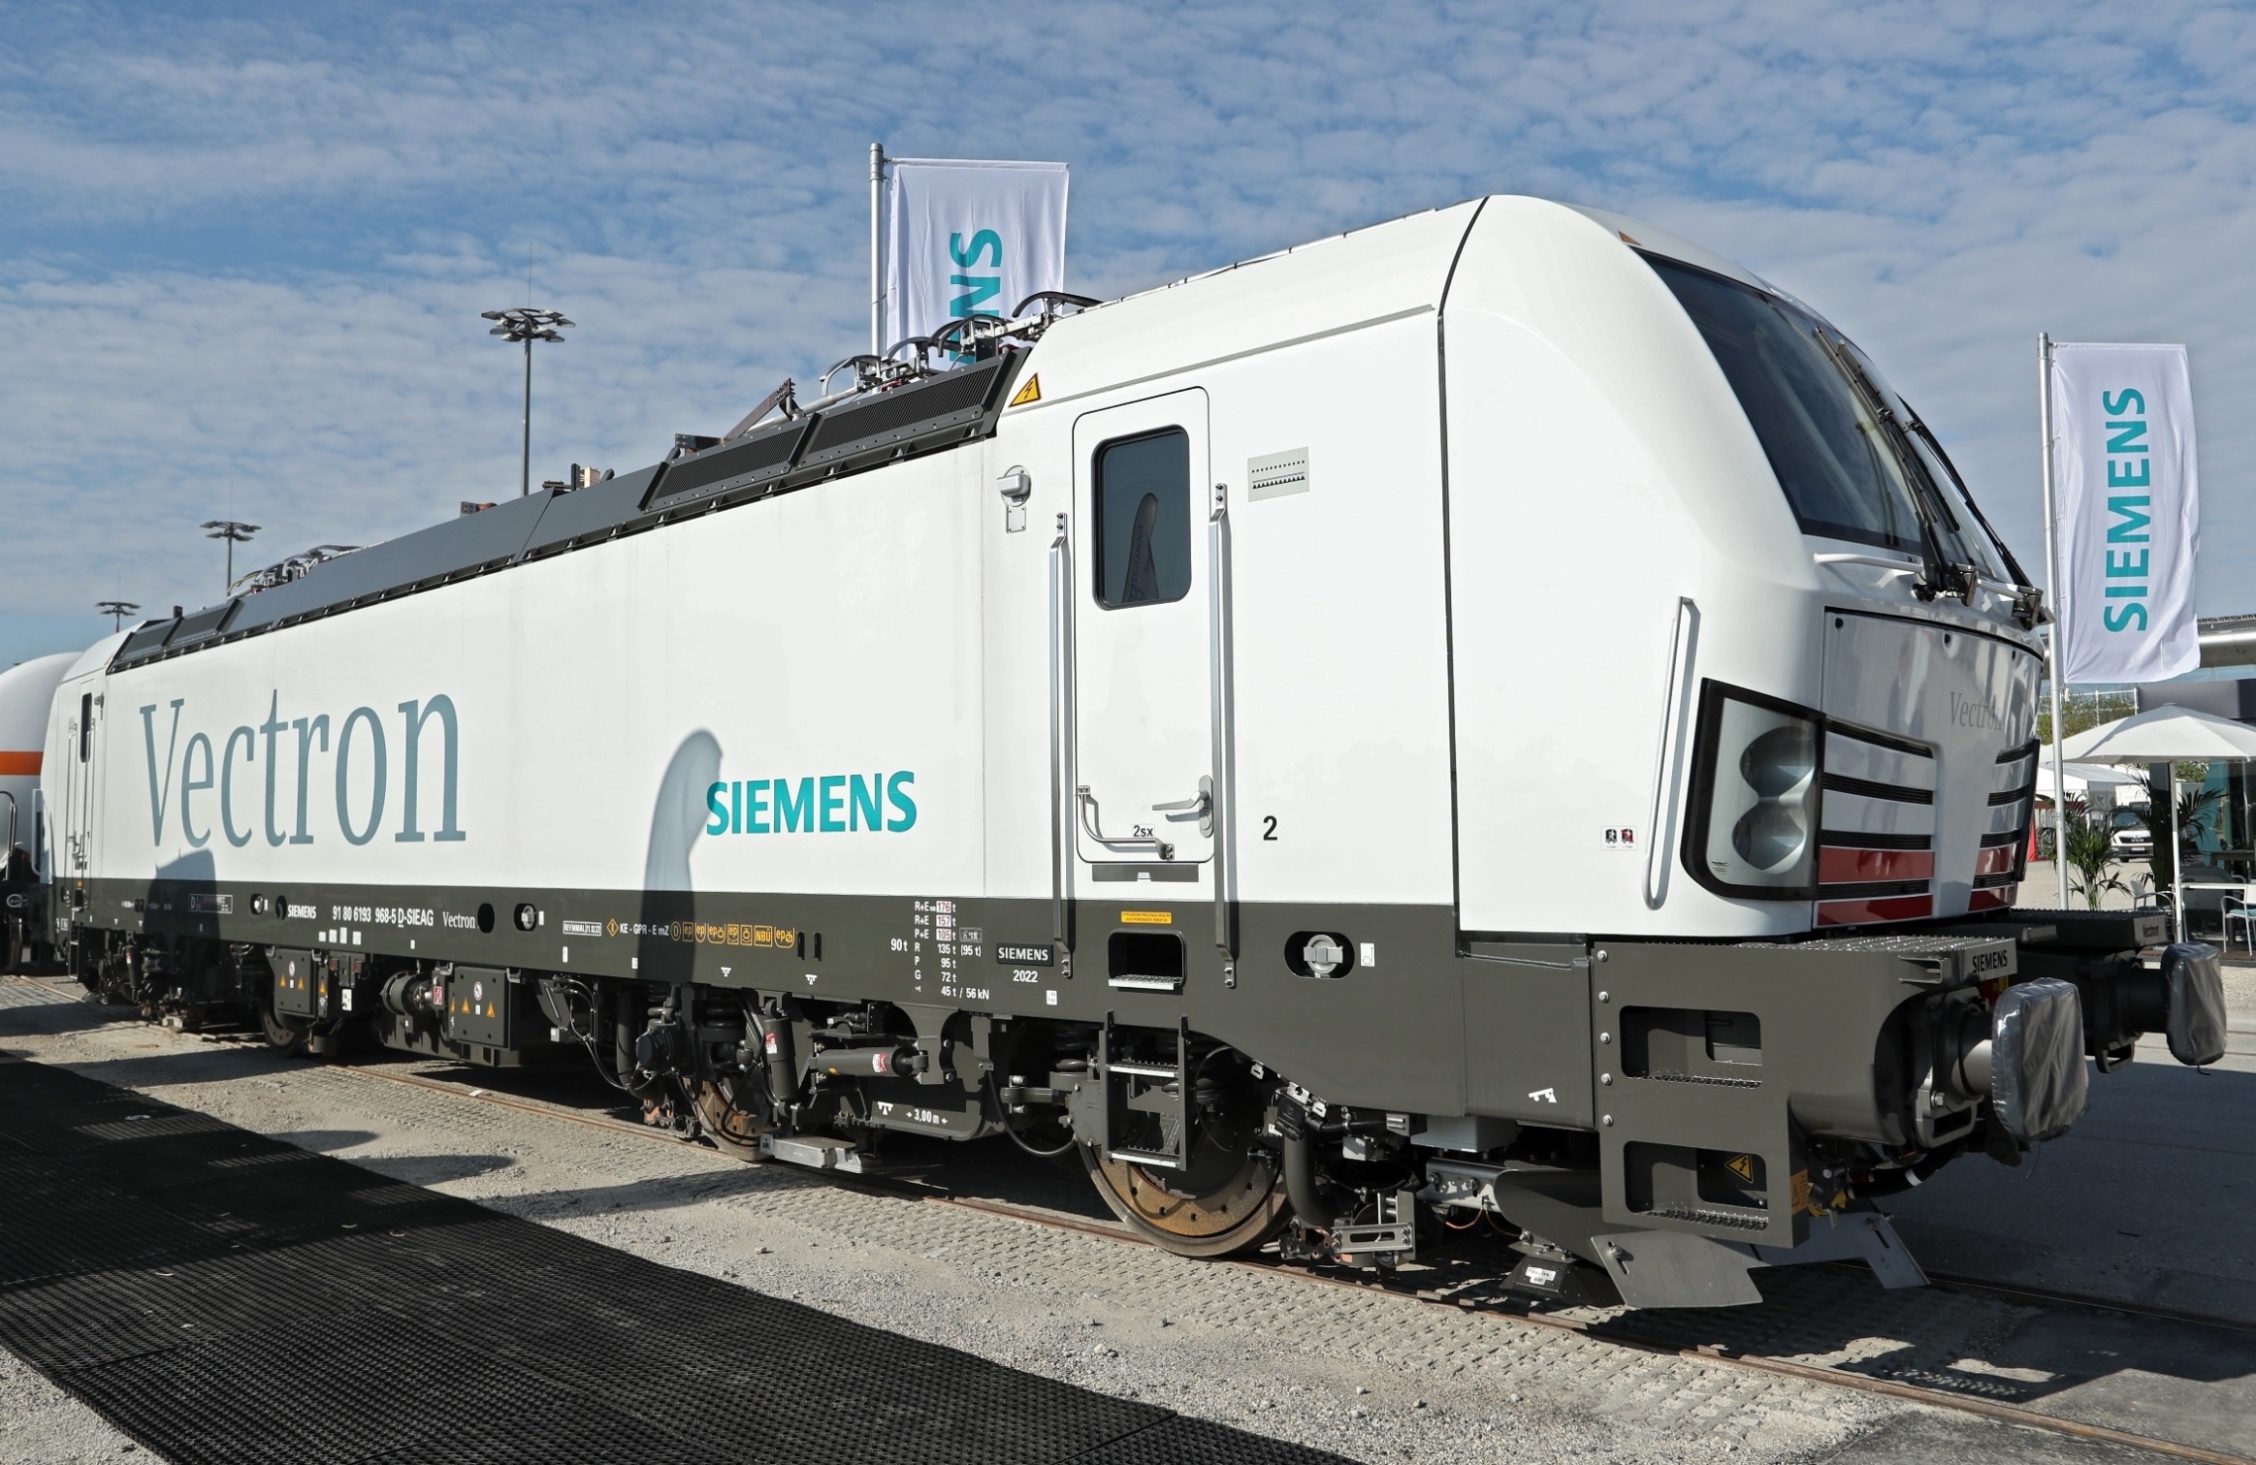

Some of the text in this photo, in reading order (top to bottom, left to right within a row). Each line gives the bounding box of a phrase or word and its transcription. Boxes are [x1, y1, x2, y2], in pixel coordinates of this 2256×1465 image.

[2103, 388, 2151, 633] SIEMENS
[1950, 691, 2002, 730] Vectron
[140, 689, 466, 848] Vectron
[707, 771, 917, 836] SIEMENS
[1133, 824, 1154, 837] 2sx
[1263, 815, 1278, 841] 2
[937, 902, 951, 912] 176
[288, 904, 476, 929] SIEMENS 91 80 6193 968-5 D-SIEAG Vectron
[914, 915, 929, 925] R+E
[937, 916, 951, 926] 157
[620, 923, 629, 934] KE
[633, 924, 647, 935] GPR
[652, 925, 657, 935] E
[658, 925, 669, 936] mZ
[914, 928, 929, 939] P+E
[937, 929, 951, 940] 105
[891, 938, 901, 951] 90
[914, 942, 921, 952] R
[937, 943, 950, 954] 135
[960, 945, 973, 957] (95
[998, 947, 1049, 962] SIEMENS
[1972, 949, 2008, 974] SIEMENS
[914, 956, 920, 966] P
[941, 958, 951, 969] 95
[914, 970, 922, 980] G
[941, 972, 951, 982] 72
[1013, 969, 1038, 983] 2022
[941, 986, 951, 996] 45
[966, 988, 976, 999] 56
[977, 988, 990, 1000] kN
